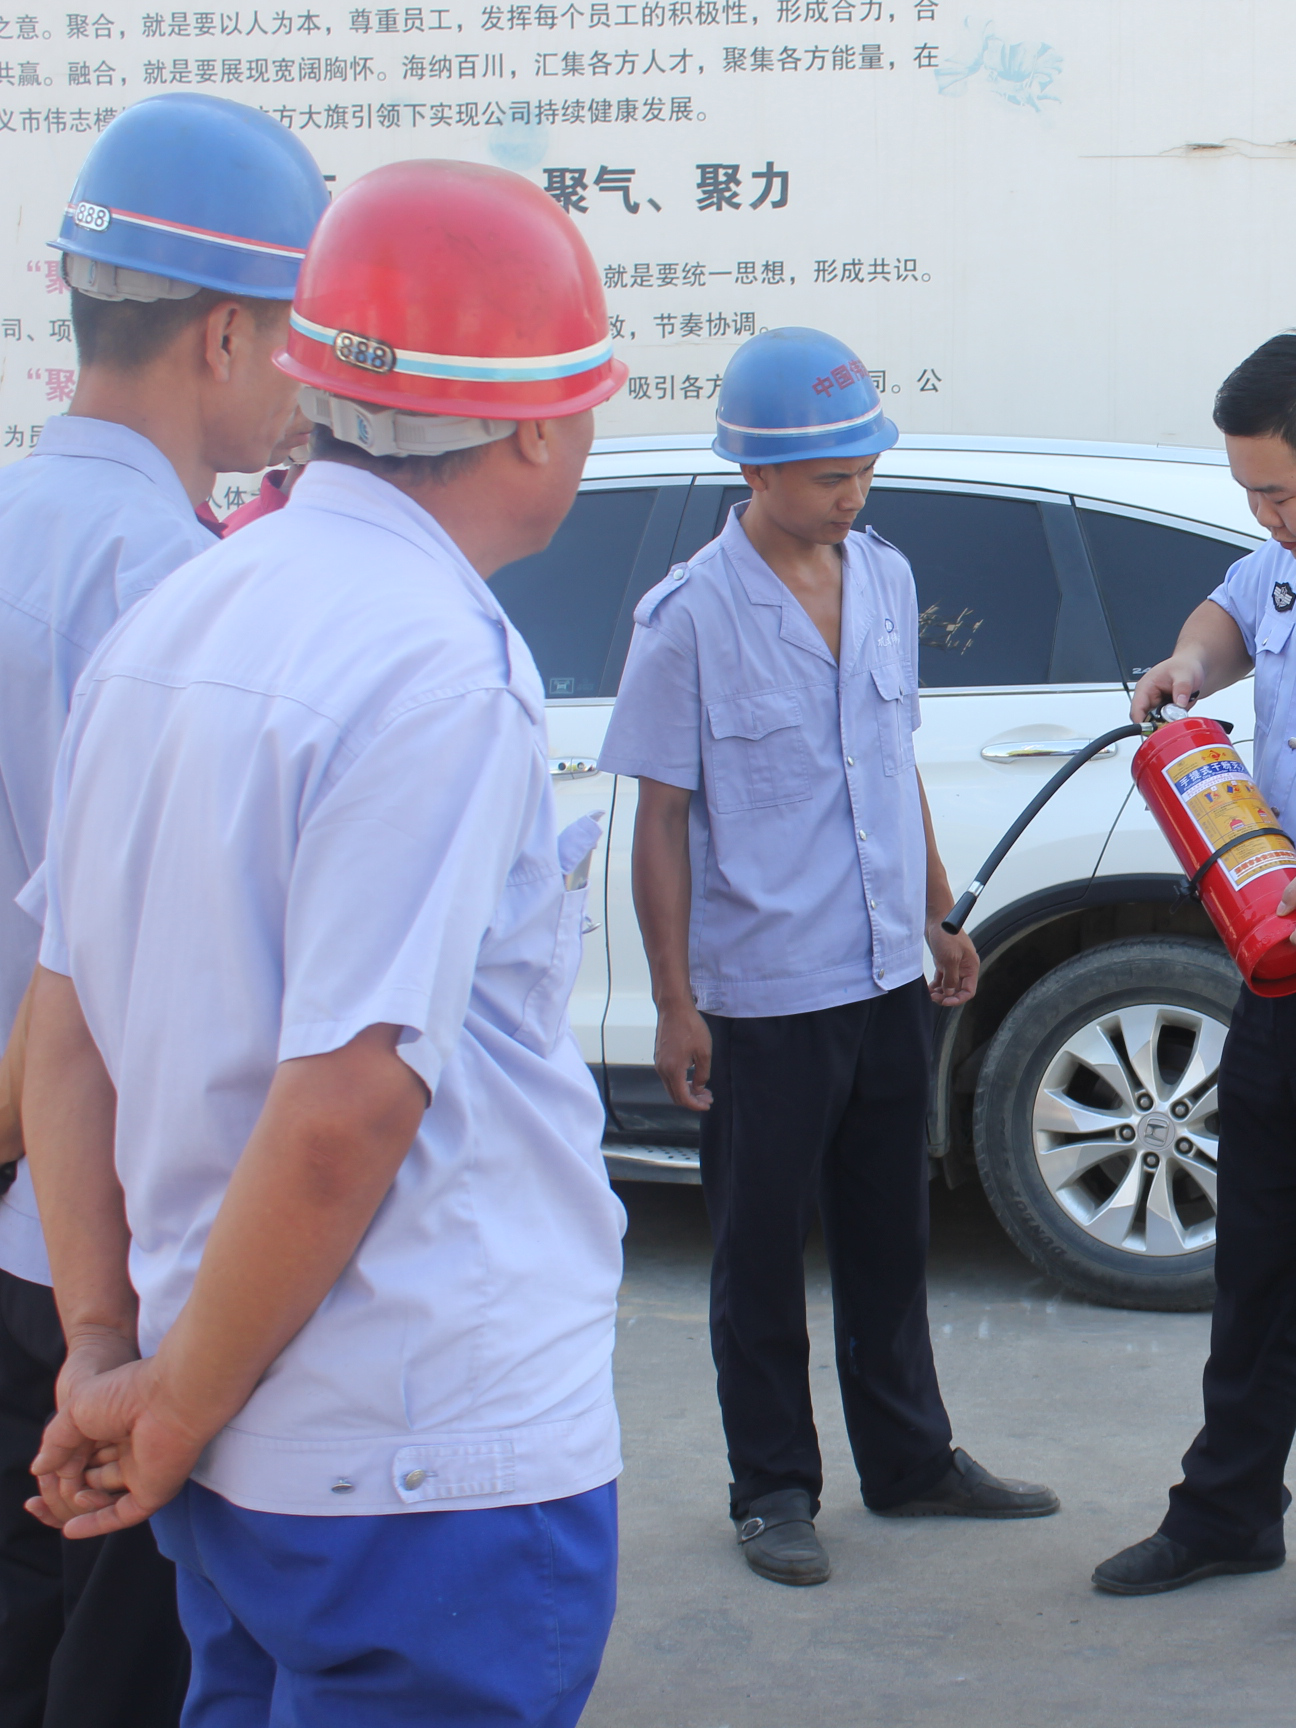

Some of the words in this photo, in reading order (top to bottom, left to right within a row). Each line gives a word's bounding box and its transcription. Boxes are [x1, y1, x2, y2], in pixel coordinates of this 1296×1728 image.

[0, 106, 126, 134] 义市伟志模
[258, 97, 708, 130] 方大旗引领下实现公司持续健康发展。
[77, 204, 106, 227] 888
[340, 335, 386, 369] 888
